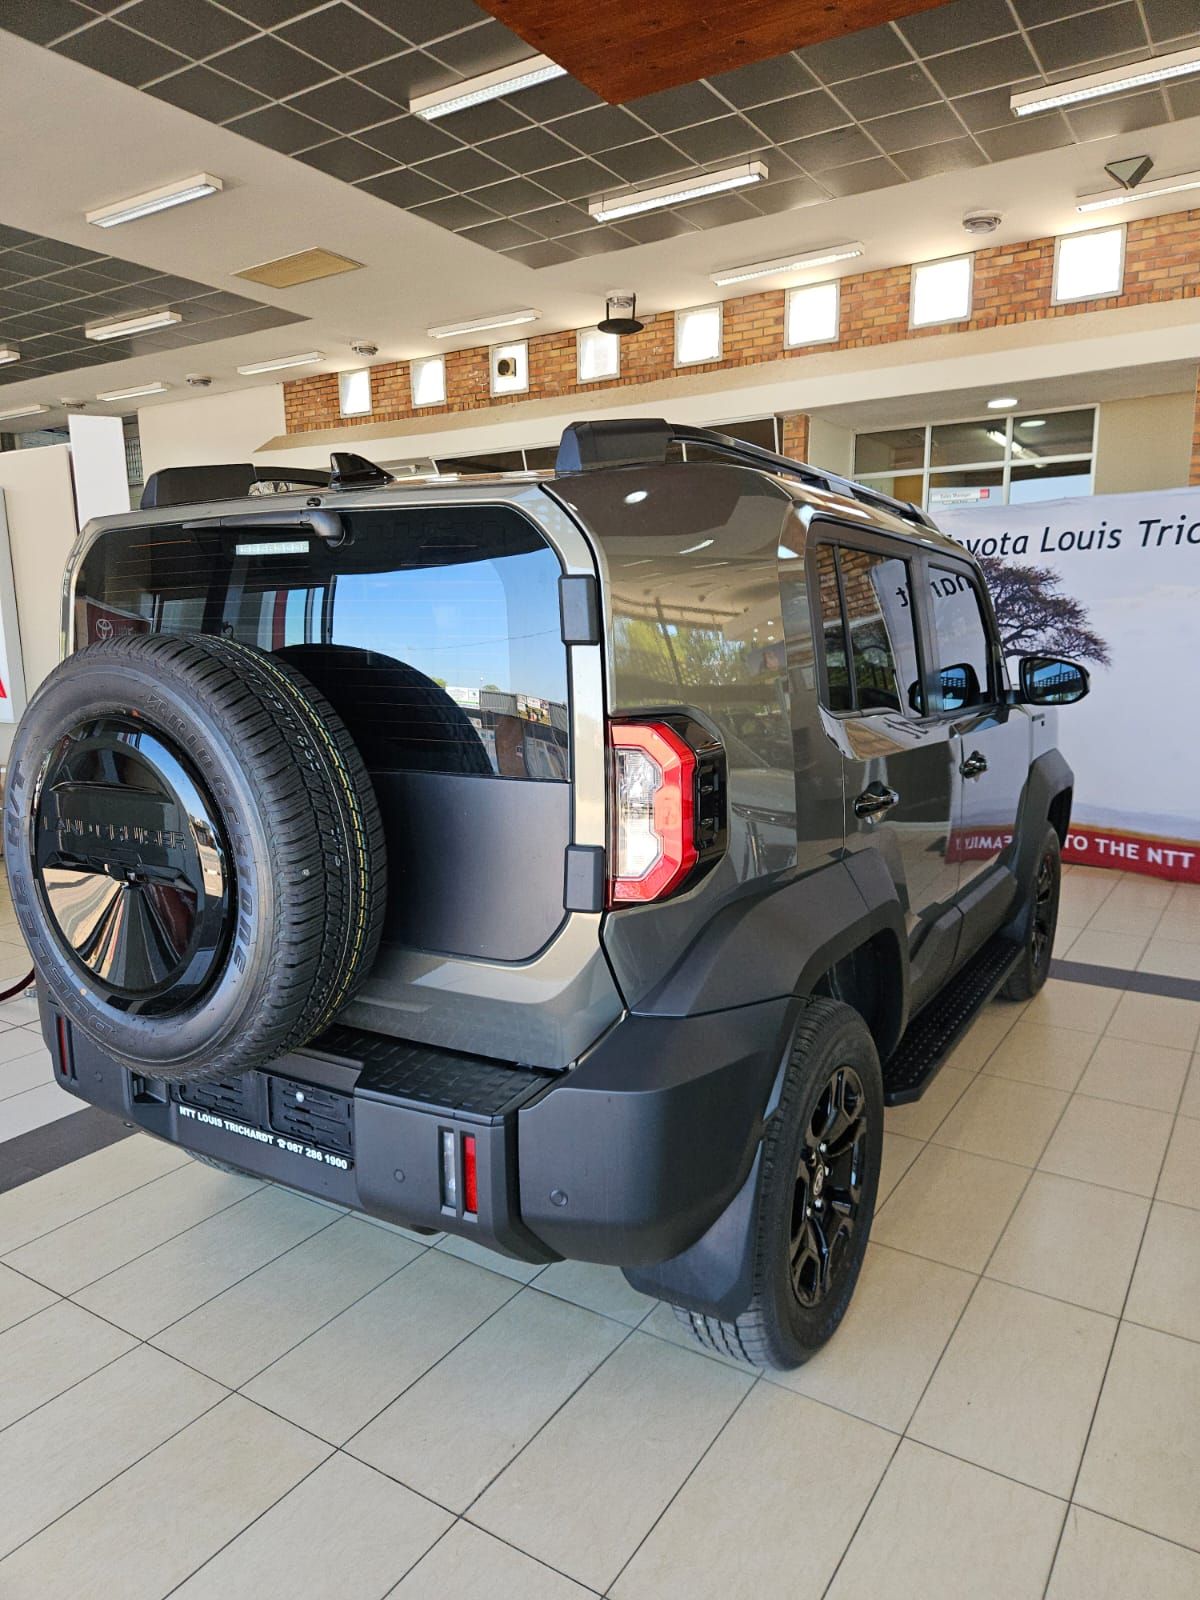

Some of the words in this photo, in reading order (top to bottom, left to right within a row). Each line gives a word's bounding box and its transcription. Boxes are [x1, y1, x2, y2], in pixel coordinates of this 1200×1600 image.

[946, 531, 1029, 557] yota
[1040, 521, 1123, 553] Louis
[1063, 834, 1088, 851] TO
[1095, 838, 1140, 860] THE
[1147, 846, 1195, 869] NTT
[179, 1105, 196, 1119] NTT
[197, 1112, 223, 1128] LOUIS
[223, 1120, 274, 1145] TRICHARDT
[286, 1141, 304, 1154] 087
[305, 1147, 323, 1162] 286
[324, 1154, 348, 1170] 1900
